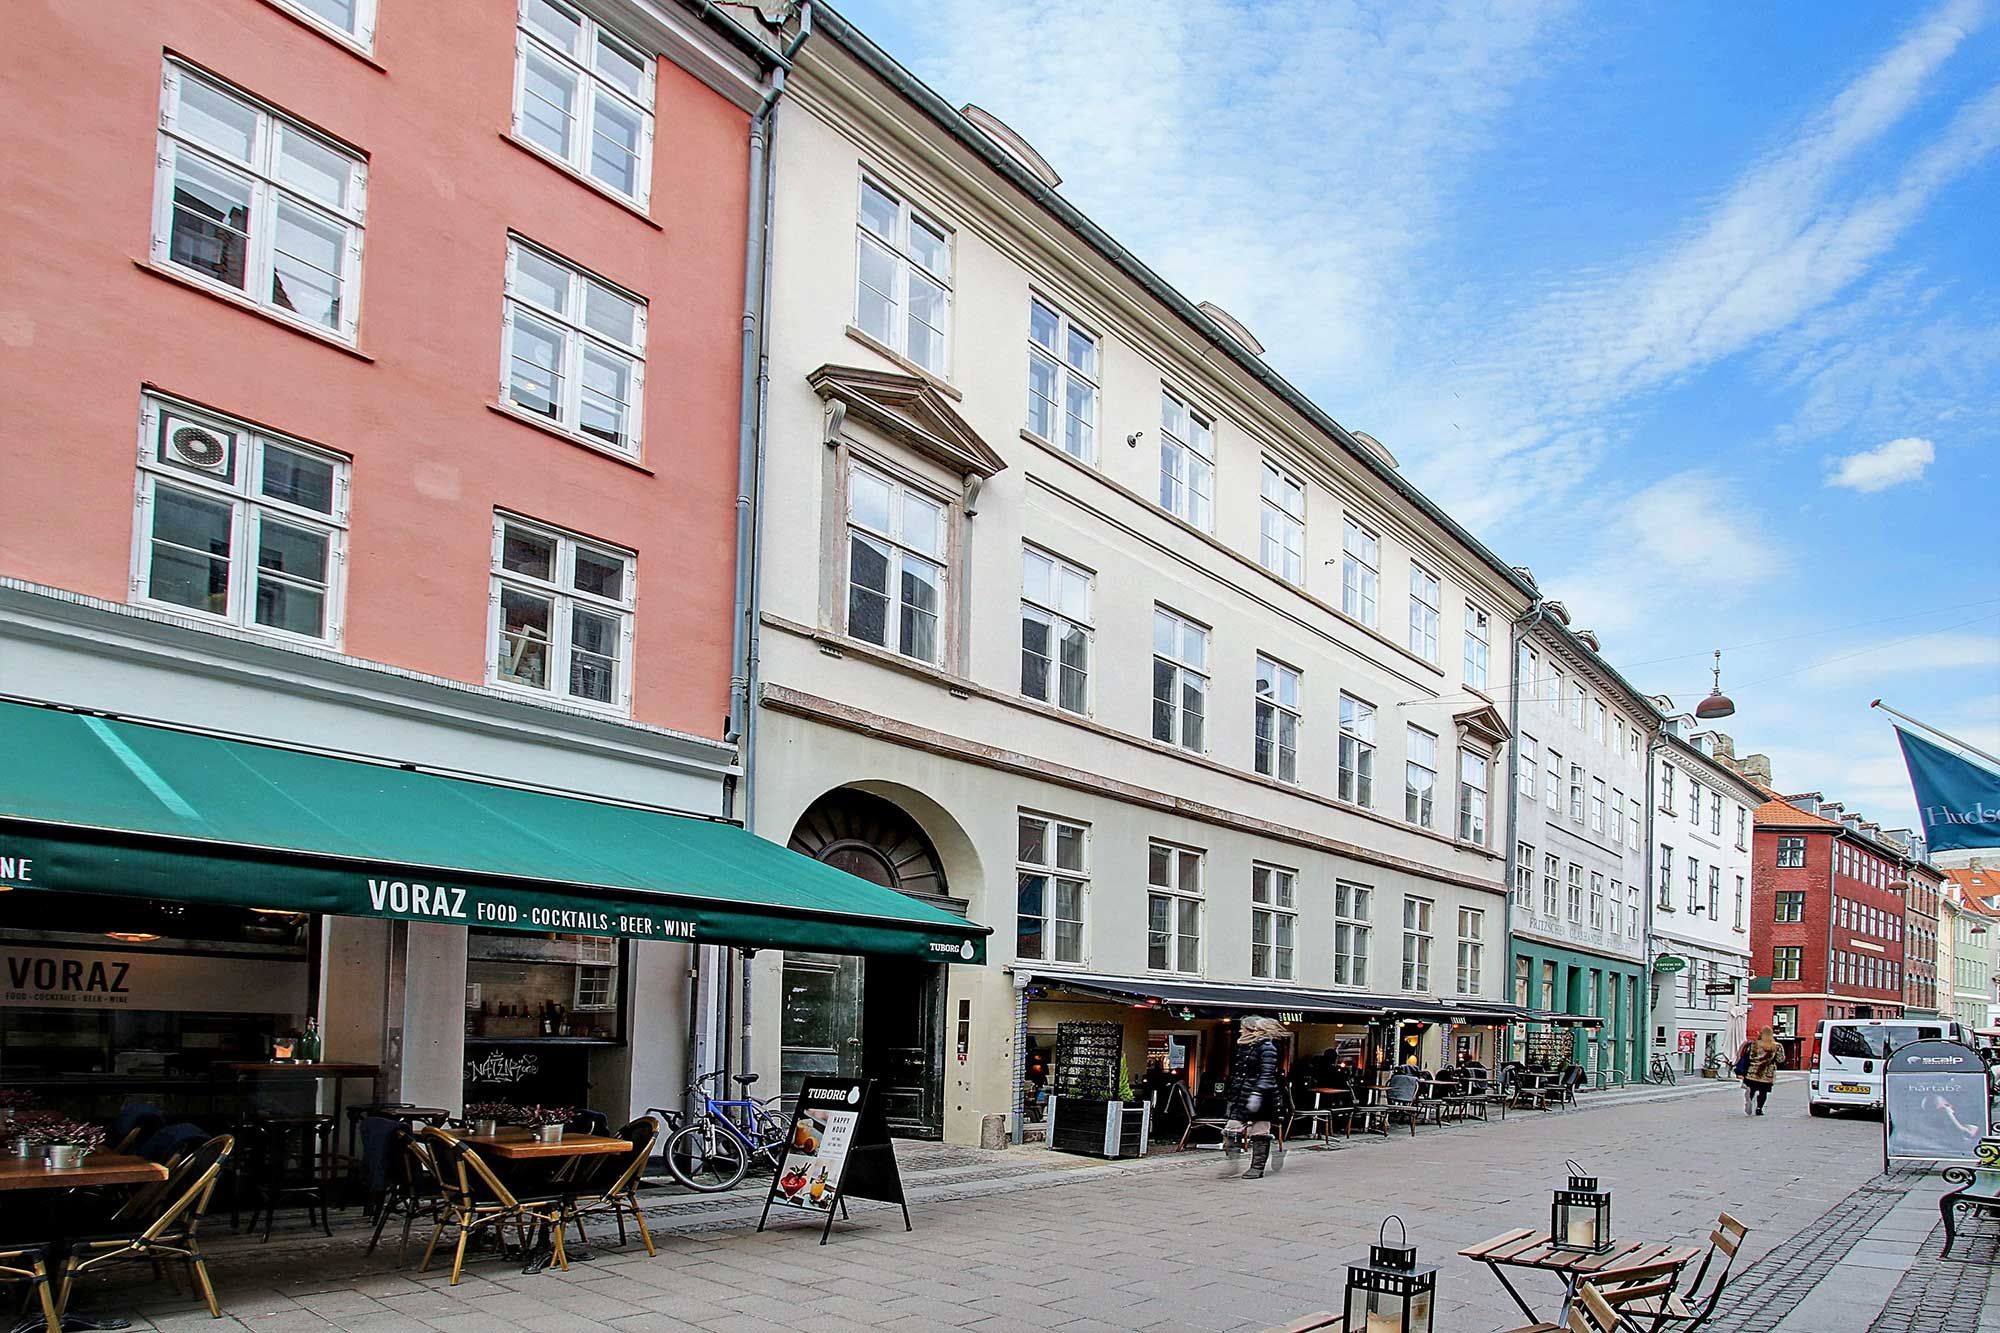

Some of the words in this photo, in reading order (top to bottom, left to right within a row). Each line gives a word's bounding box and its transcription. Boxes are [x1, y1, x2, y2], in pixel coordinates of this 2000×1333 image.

[368, 879, 467, 918] VORAZ
[477, 902, 518, 923] FOOD
[532, 907, 608, 931] COCKTAILS
[620, 915, 653, 935] BEER
[664, 919, 697, 938] WINE
[929, 942, 960, 953] TUBORG
[8, 956, 130, 993] VORAZ
[5, 991, 28, 1001] FOOD
[34, 992, 77, 1003] COCKTAILS
[83, 994, 104, 1003] BEER
[110, 995, 129, 1004] WINE
[1922, 1055, 1964, 1065] scalp
[808, 1088, 847, 1101] TUBORG
